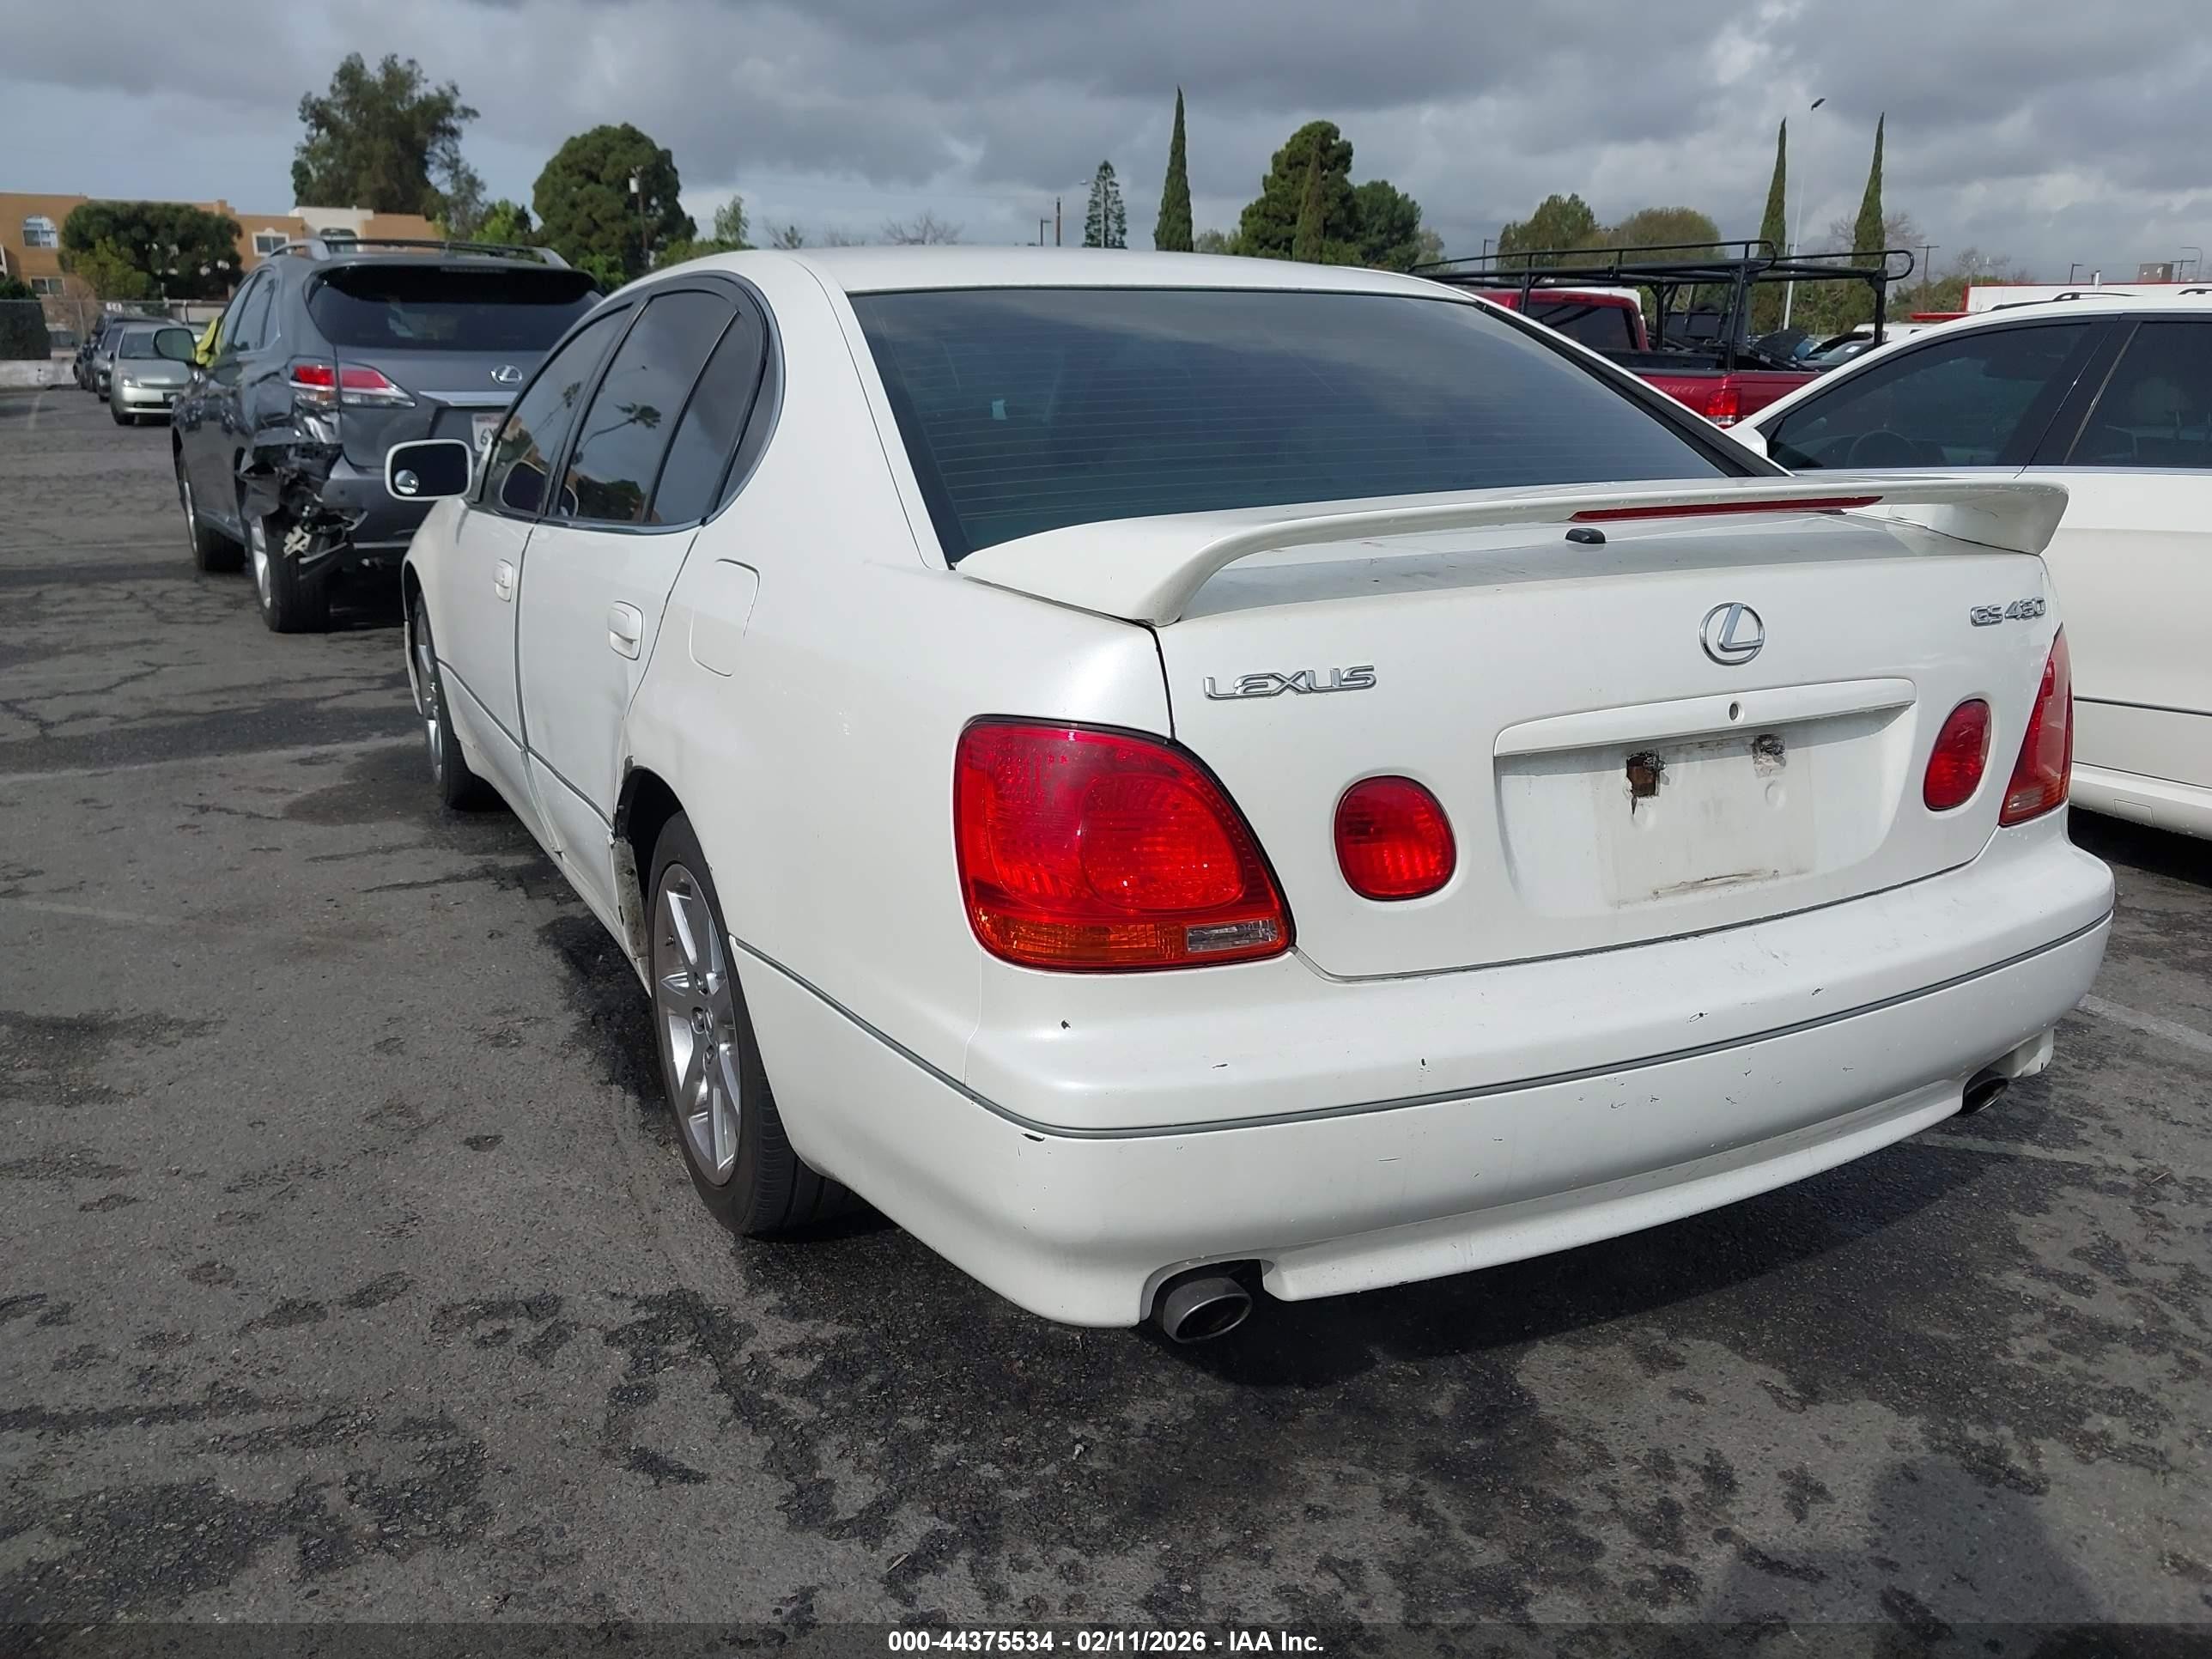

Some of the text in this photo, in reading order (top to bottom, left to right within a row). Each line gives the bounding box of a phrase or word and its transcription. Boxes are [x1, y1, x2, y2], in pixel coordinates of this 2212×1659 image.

[1970, 596, 2046, 627] GS 430
[1203, 665, 1377, 701] LEXUS
